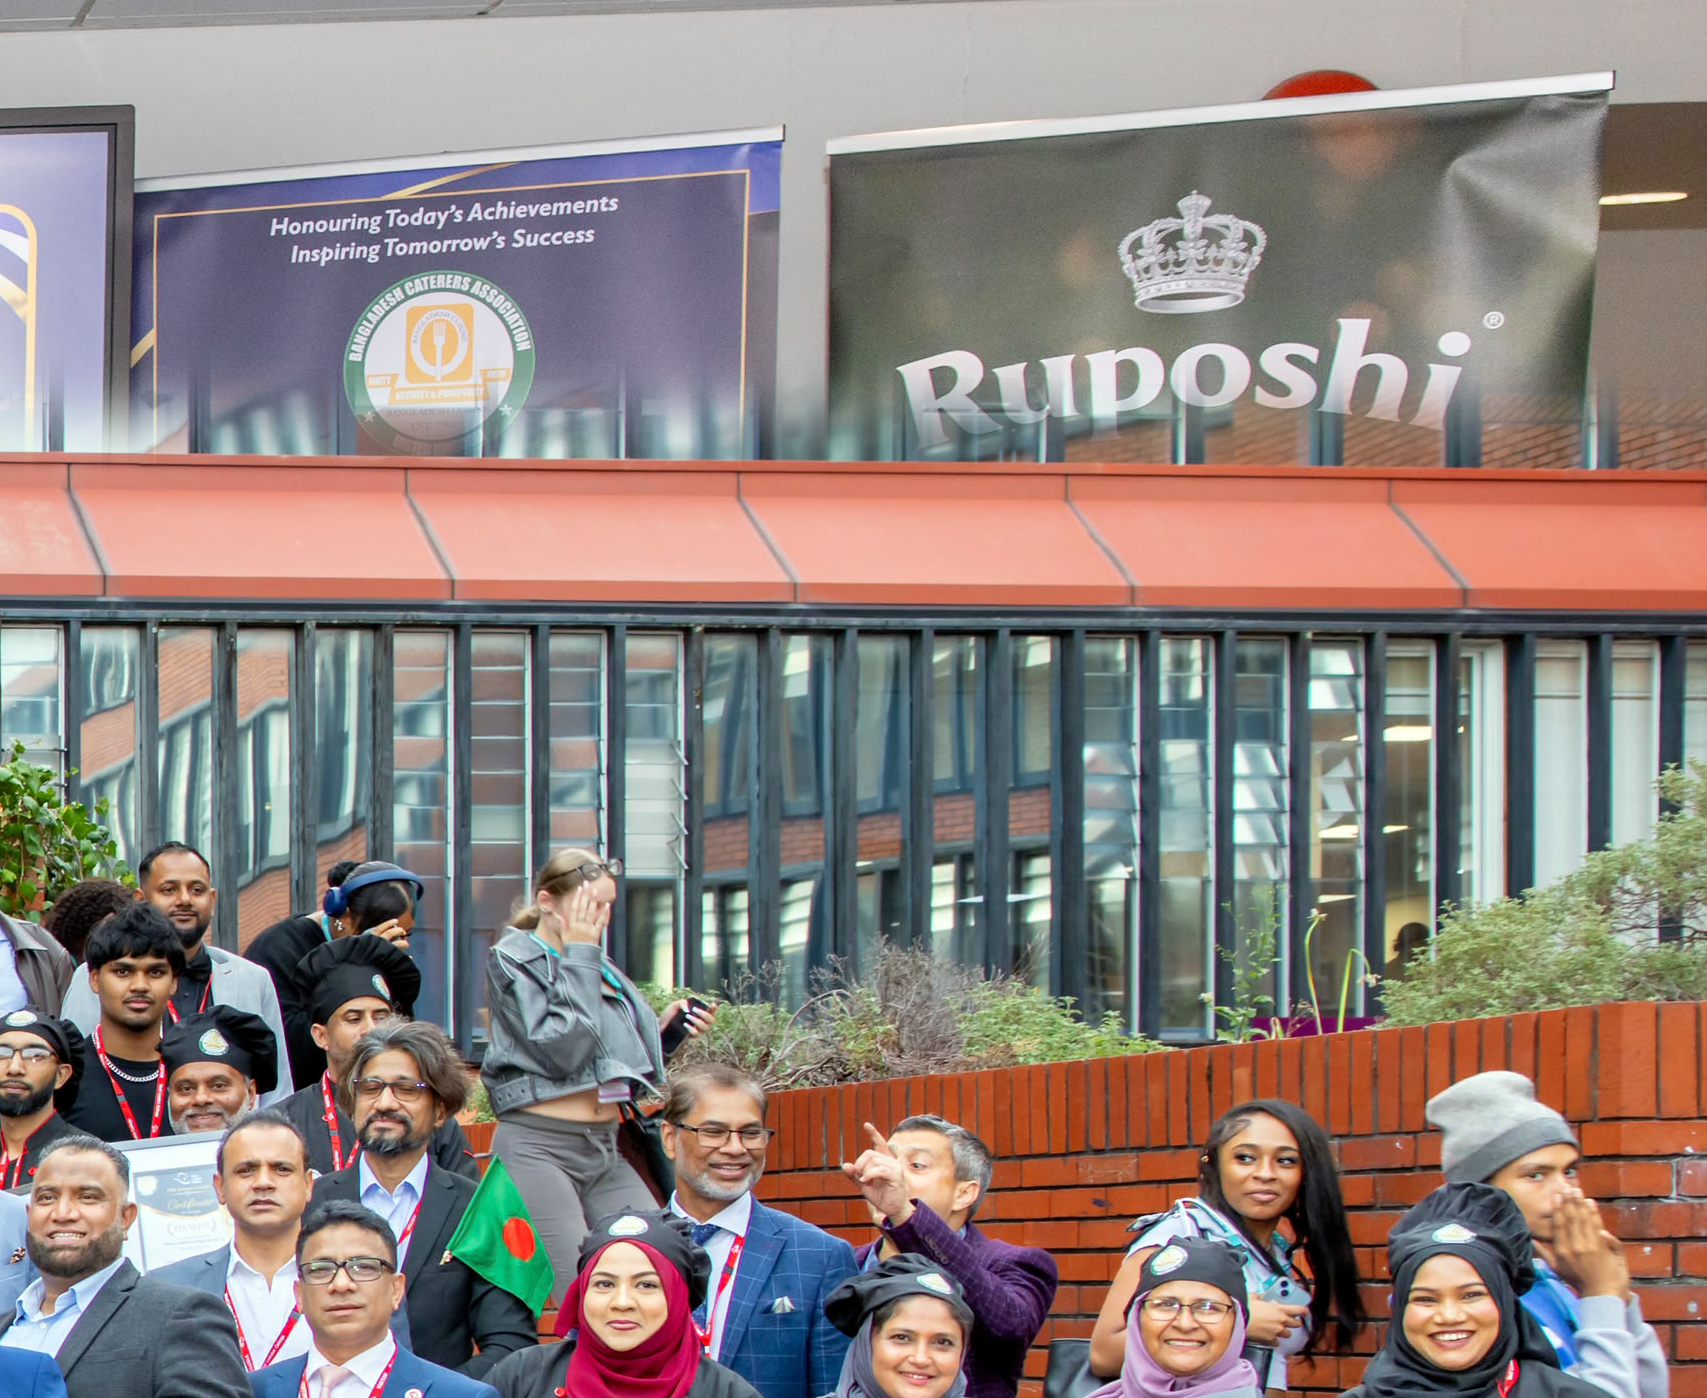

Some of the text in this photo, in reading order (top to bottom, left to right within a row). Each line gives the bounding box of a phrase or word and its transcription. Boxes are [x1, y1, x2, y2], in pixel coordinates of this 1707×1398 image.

[270, 196, 619, 236] Honouring Today's Achievements
[290, 228, 596, 266] Inspiring Tomorrow's Success
[348, 284, 406, 362] BANGLADESH
[404, 274, 472, 296] CATERERS
[470, 281, 532, 352] ASSOCIATION
[895, 317, 1472, 451] Ruposhi
